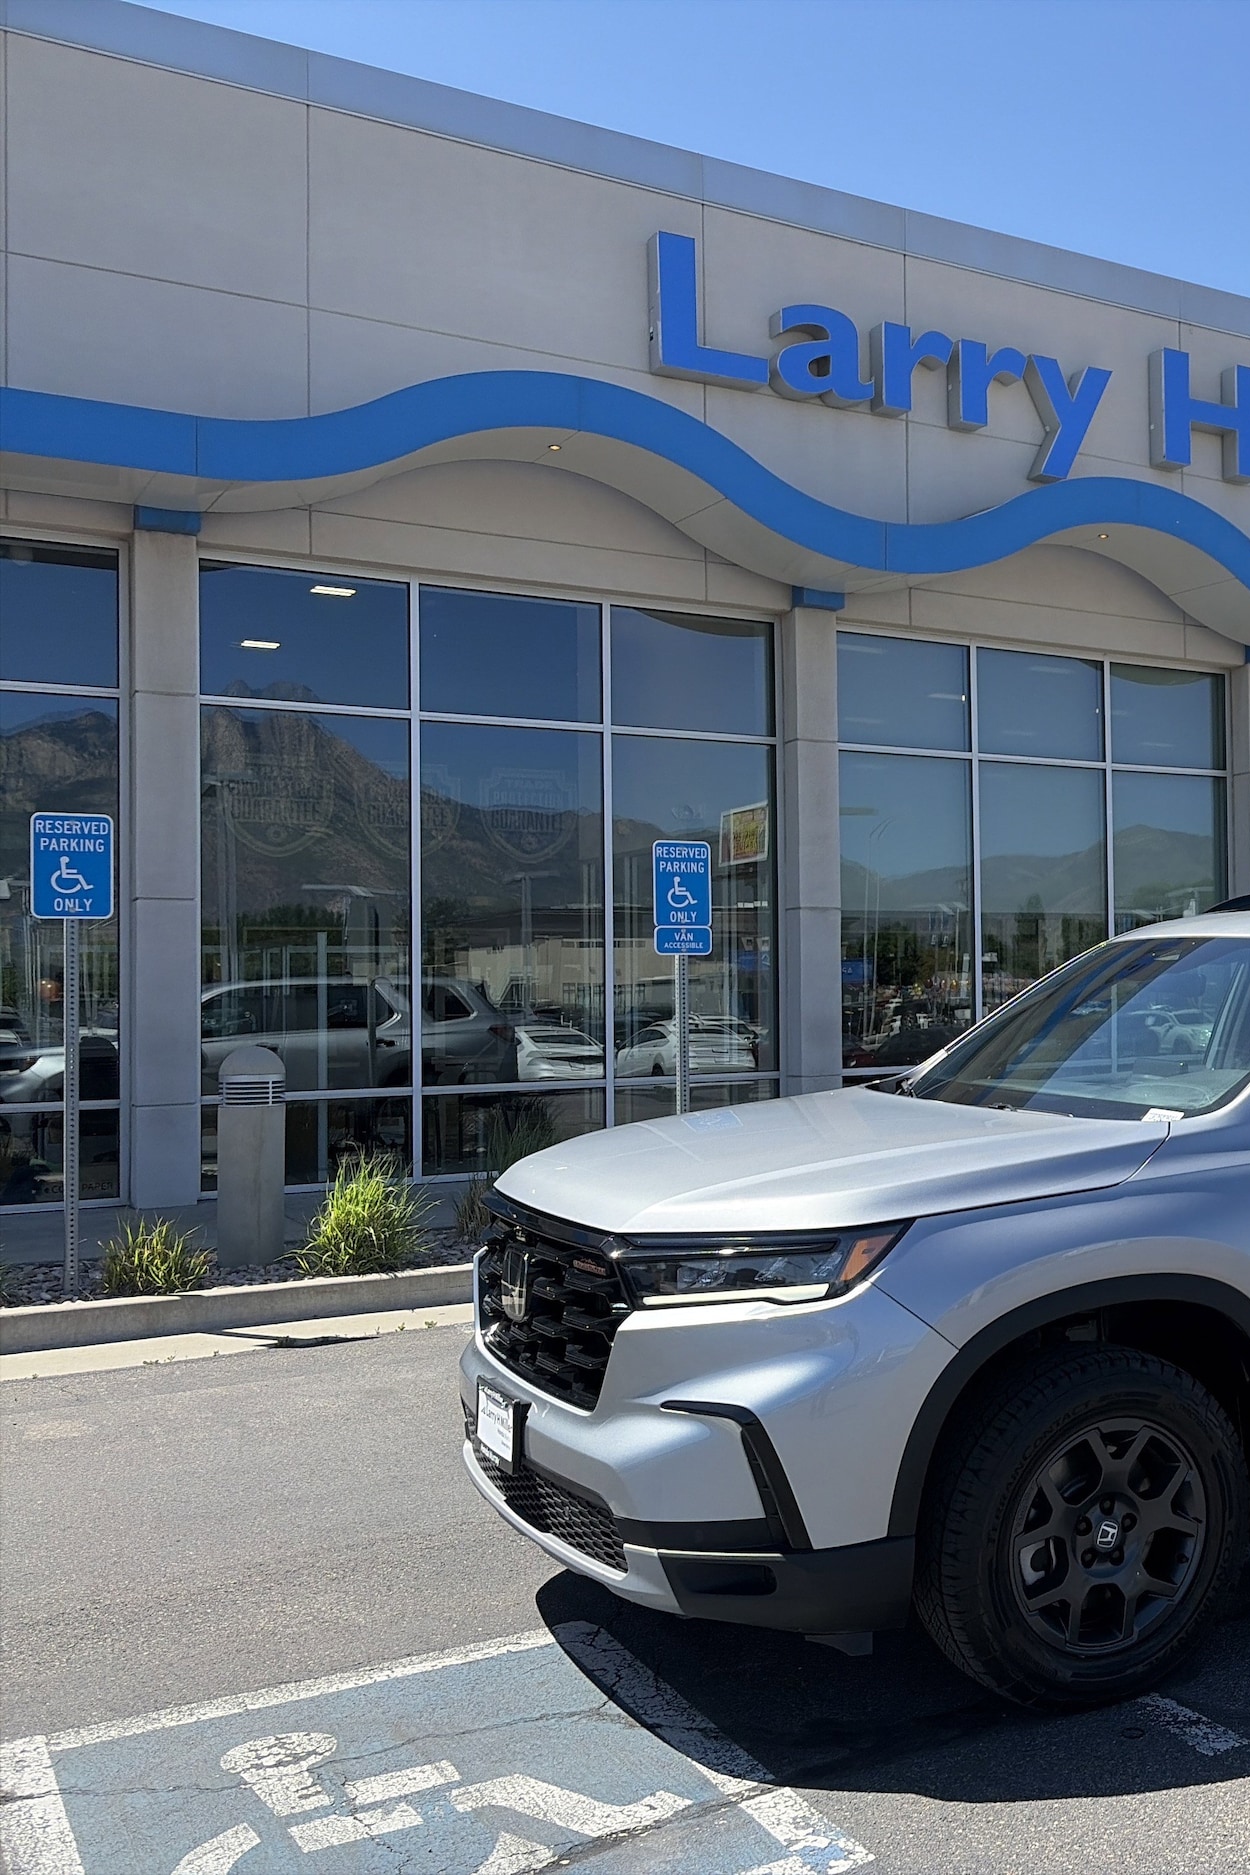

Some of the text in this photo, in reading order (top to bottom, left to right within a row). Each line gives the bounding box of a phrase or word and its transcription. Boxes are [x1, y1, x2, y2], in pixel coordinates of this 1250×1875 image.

[648, 230, 1113, 483] Larry
[35, 820, 109, 835] RESERVED
[40, 838, 104, 853] PARKING
[656, 846, 707, 859] RESERVED
[659, 861, 705, 873] PARKING
[54, 898, 93, 912] ONLY
[670, 911, 697, 923] ONLY
[674, 932, 694, 941] VAN
